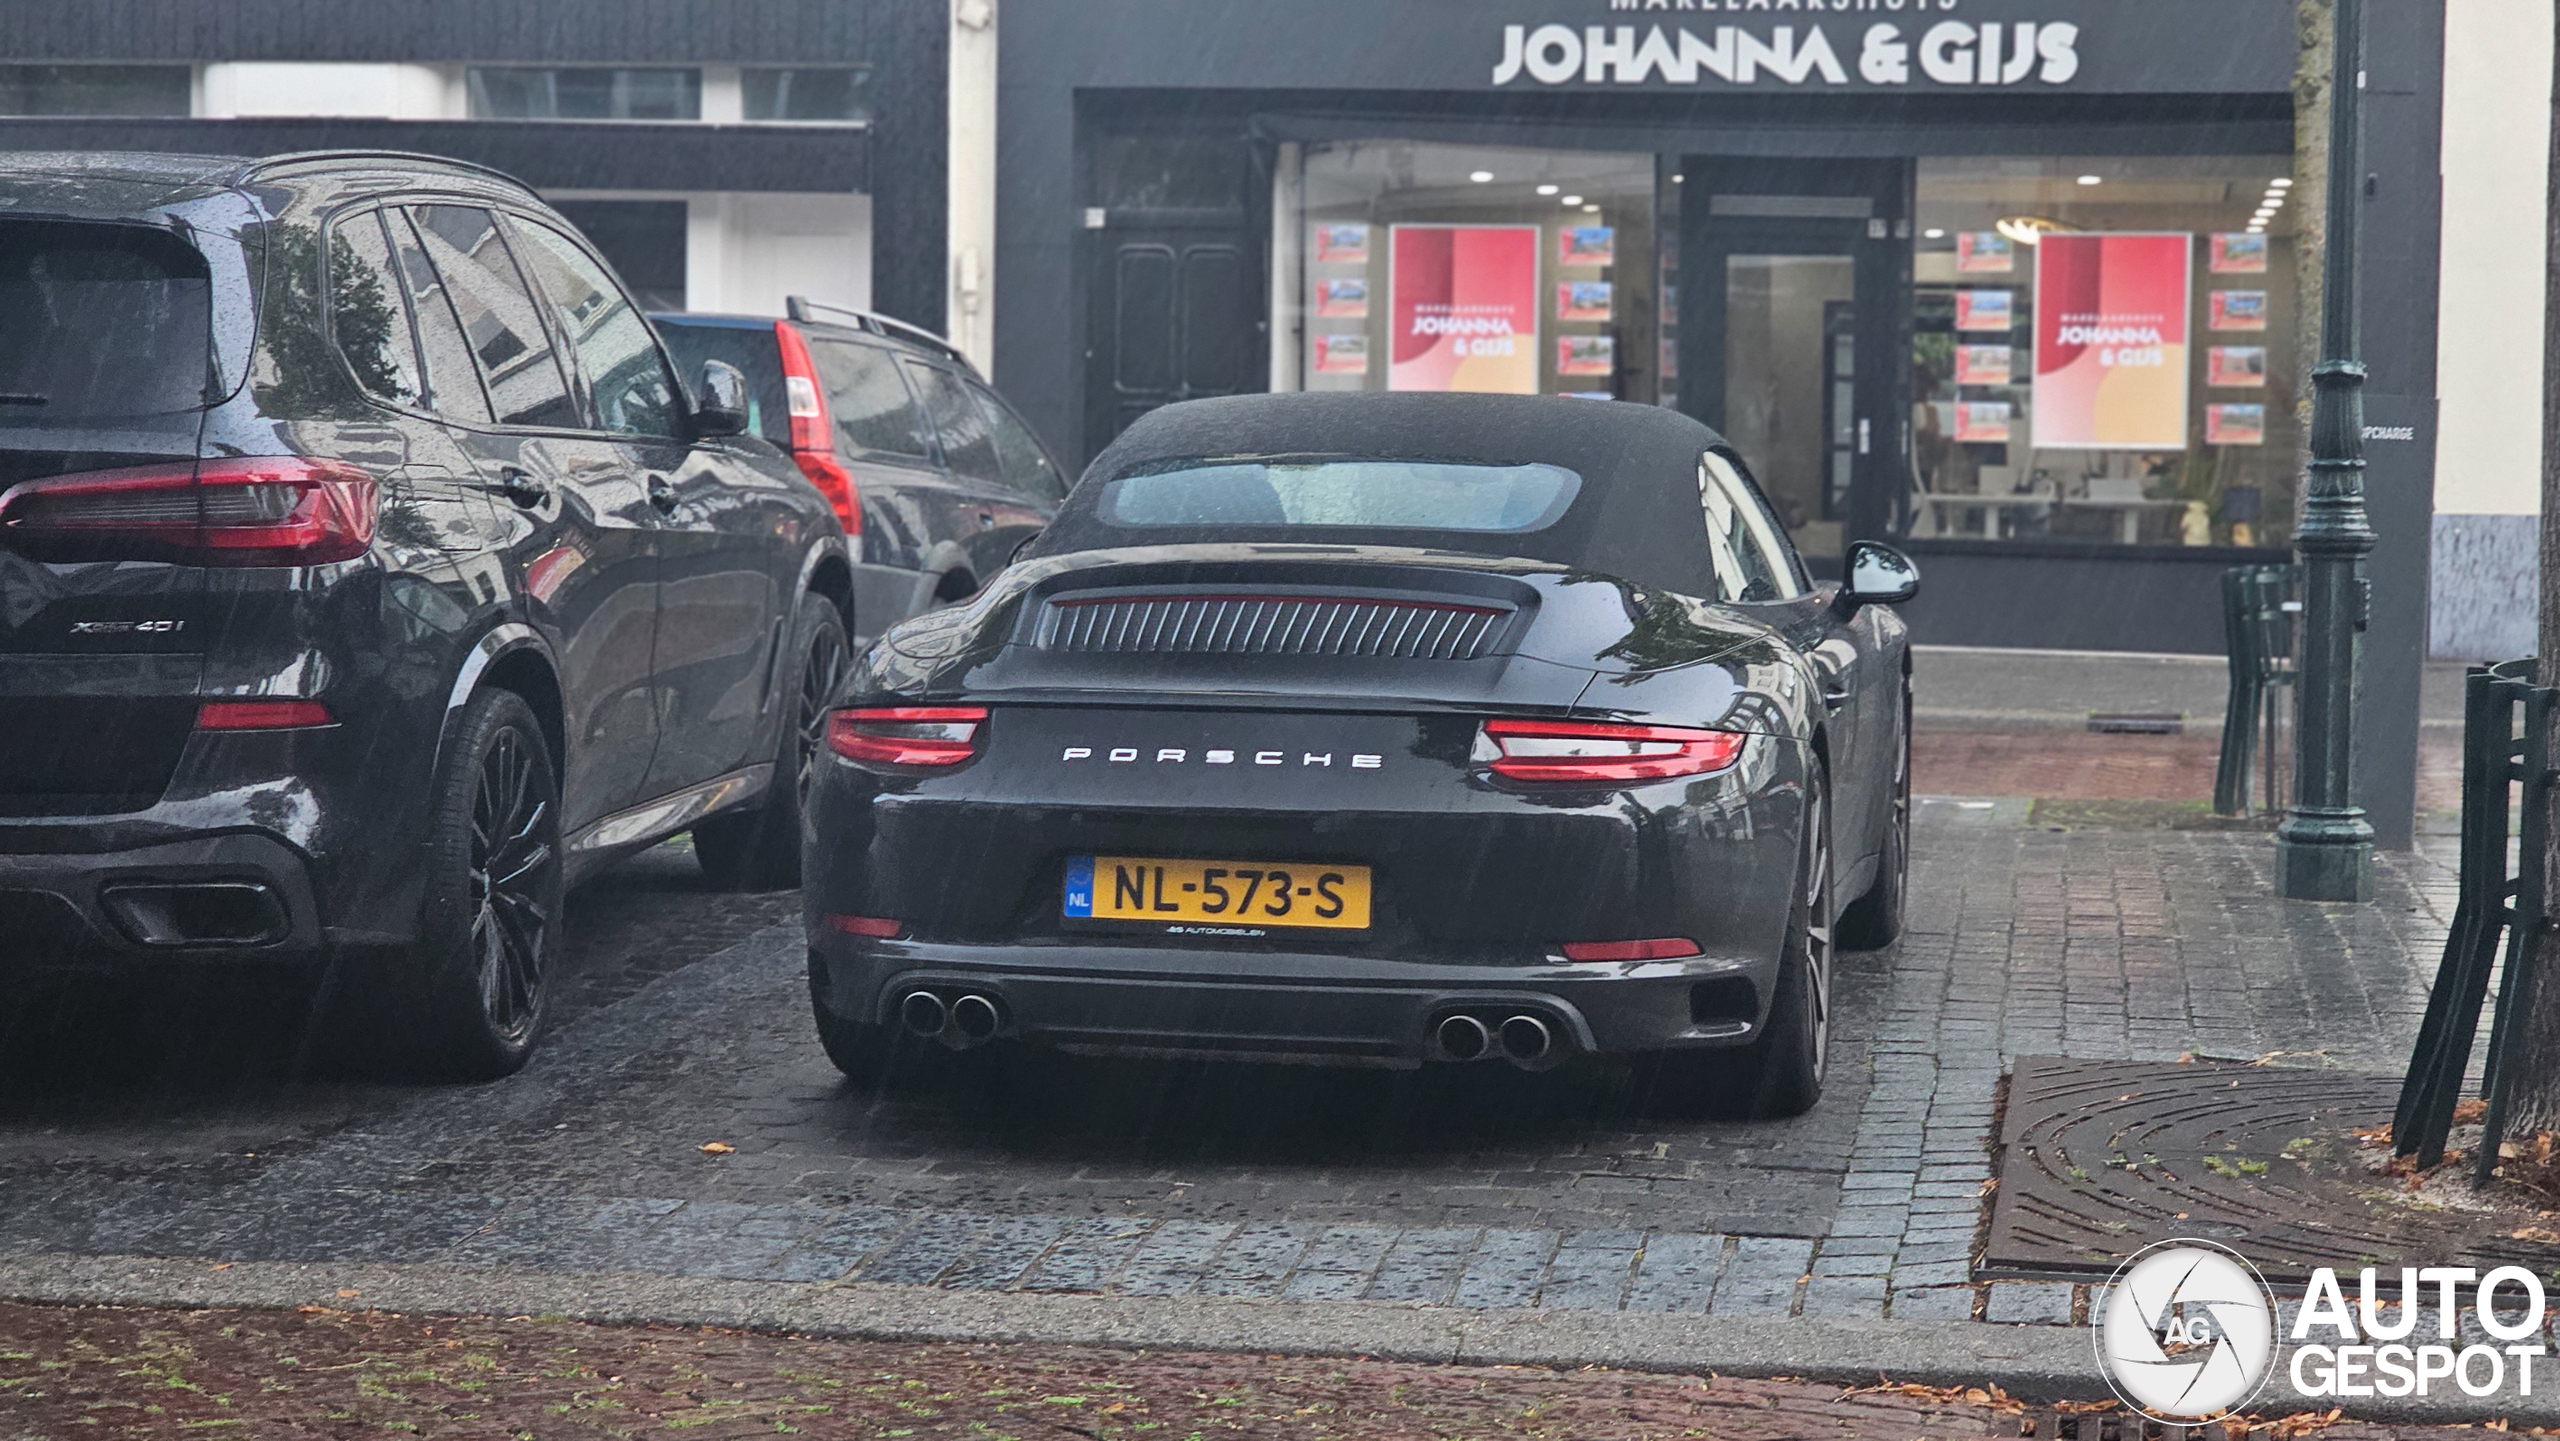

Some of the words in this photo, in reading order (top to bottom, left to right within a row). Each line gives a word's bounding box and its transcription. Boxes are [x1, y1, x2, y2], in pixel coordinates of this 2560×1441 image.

[1493, 25, 1848, 84] JOHANNA
[1859, 23, 1908, 83] &
[1918, 21, 2078, 84] GIJS
[1411, 317, 1513, 335] JOHANNA
[2056, 326, 2162, 345] JOHANNA
[1062, 747, 1383, 768] PORSCHE
[1069, 893, 1090, 907] NL
[1115, 865, 1344, 919] NL-573-S
